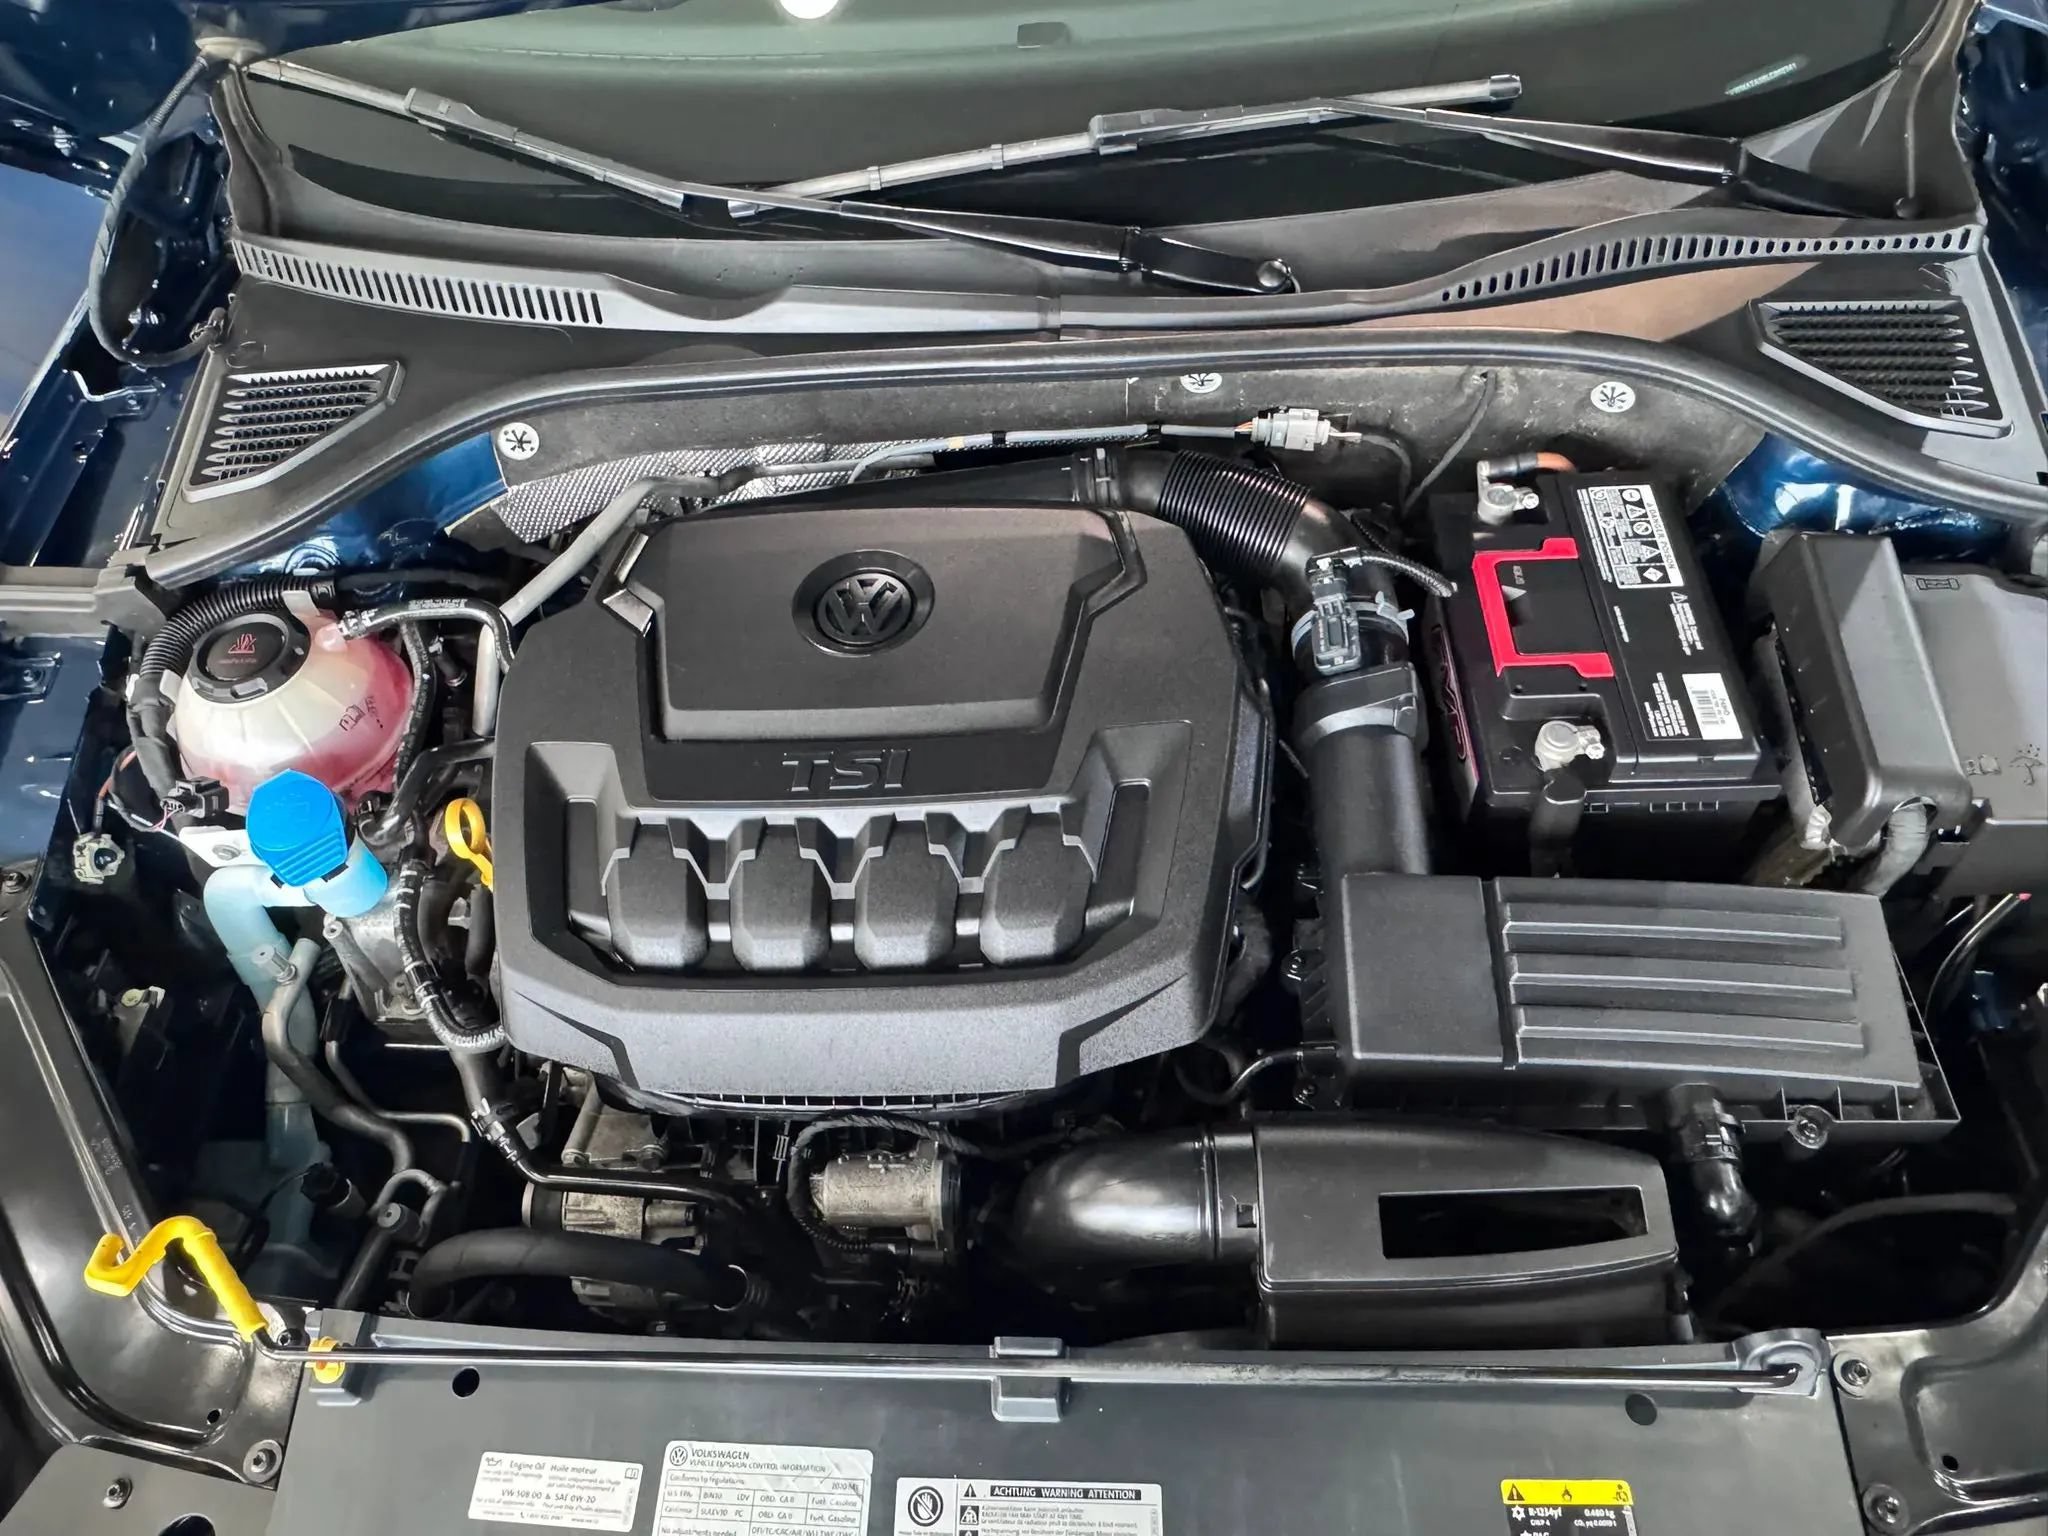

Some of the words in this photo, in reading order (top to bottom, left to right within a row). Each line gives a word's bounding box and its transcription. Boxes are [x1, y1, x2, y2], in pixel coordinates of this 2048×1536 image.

[782, 748, 911, 793] TSI
[691, 1448, 750, 1460] VOLKSWAGEN
[748, 1462, 778, 1470] CONTROL
[780, 1463, 826, 1472] INFORMATION
[993, 1486, 1037, 1497] ACHTUNG
[1040, 1487, 1084, 1498] WARNING
[1087, 1488, 1136, 1499] ATTENTION
